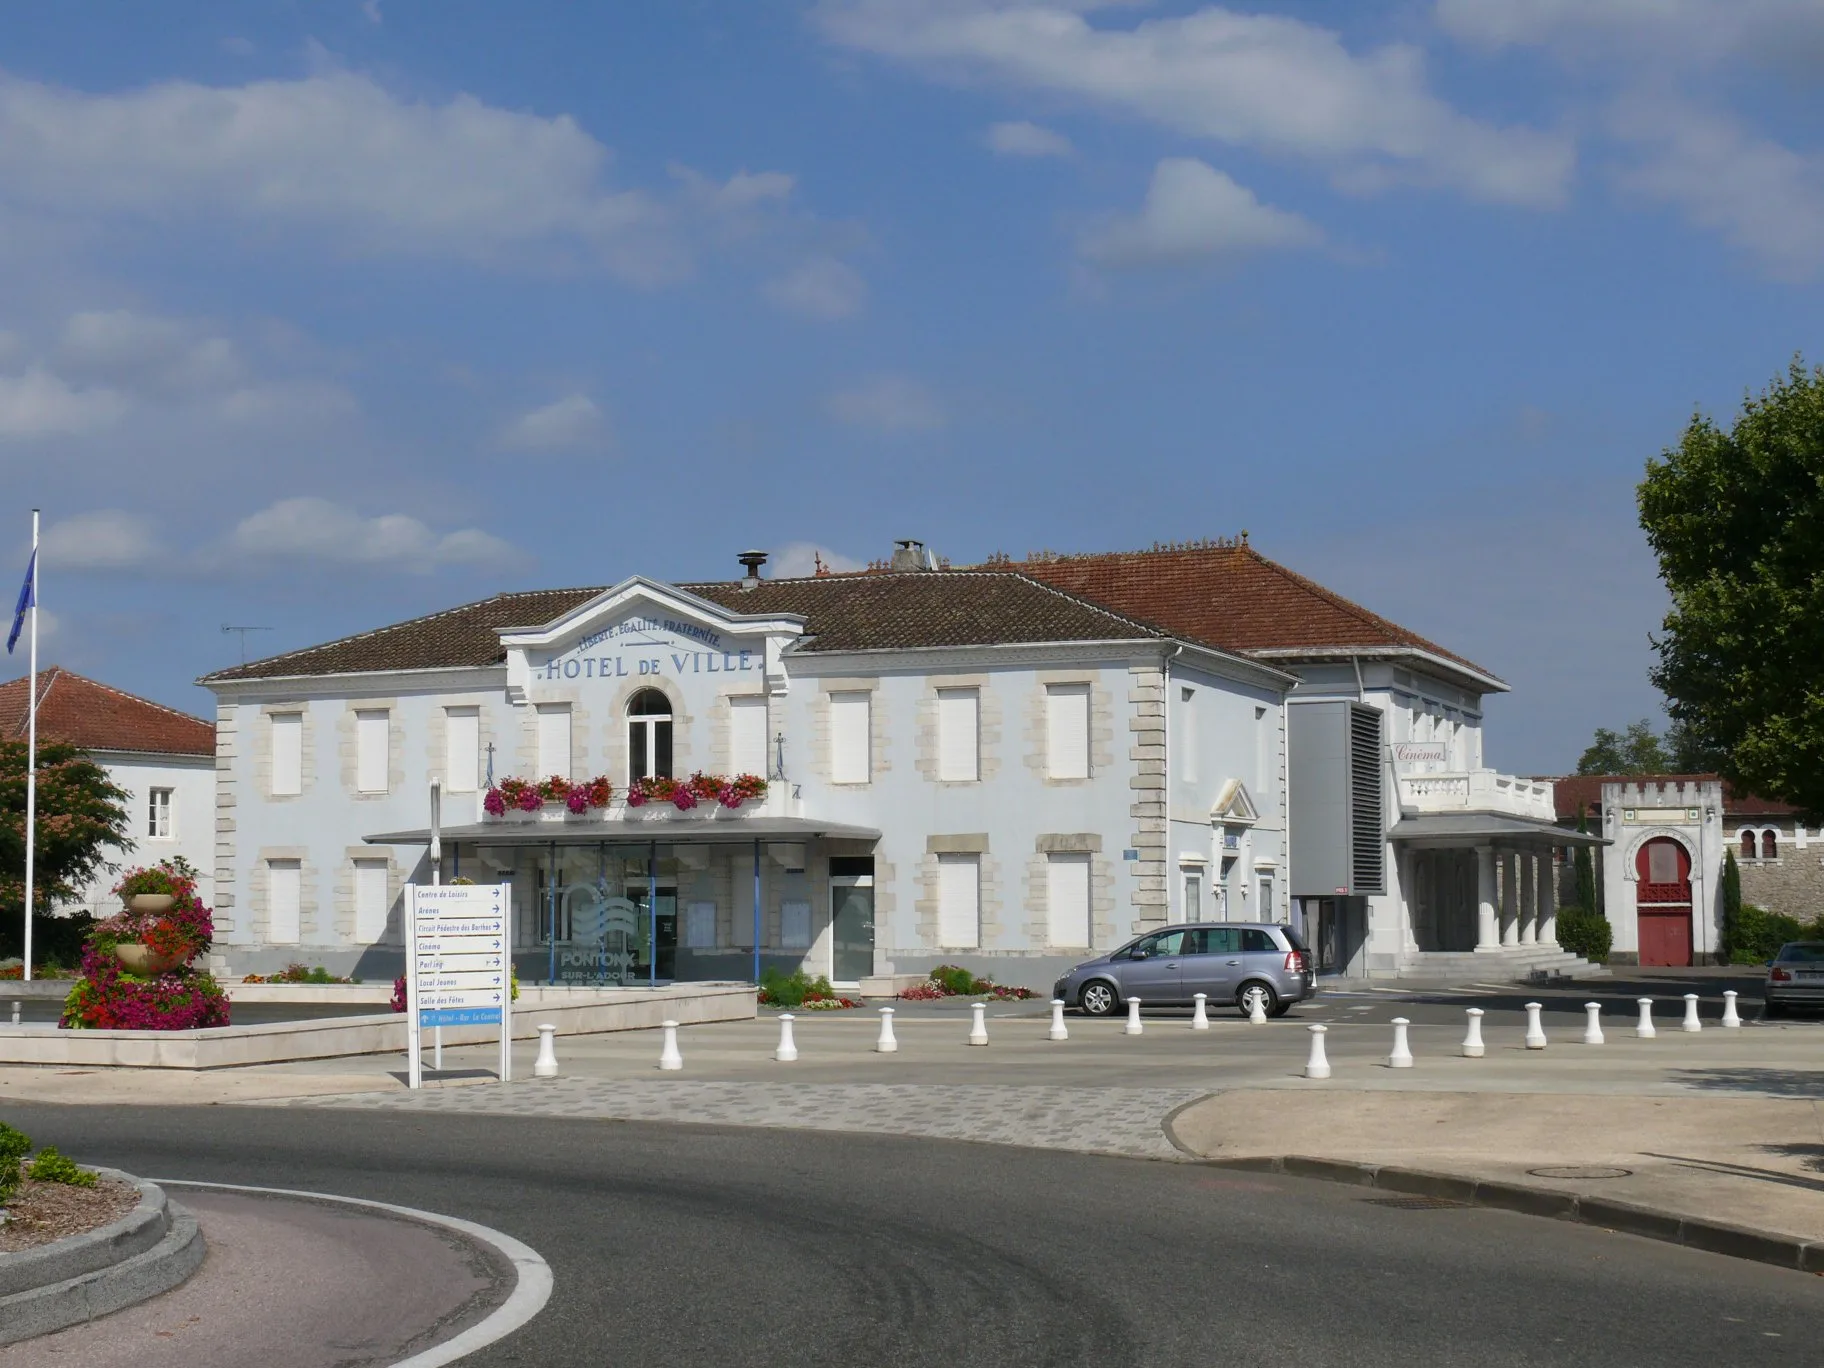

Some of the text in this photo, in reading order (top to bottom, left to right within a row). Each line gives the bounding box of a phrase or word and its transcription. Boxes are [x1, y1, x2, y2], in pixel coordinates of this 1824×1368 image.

[638, 659, 661, 676] DE
[670, 649, 753, 675] VILLE
[448, 890, 468, 898] Loisirs
[460, 923, 470, 931] des
[436, 978, 457, 986] Jeunes
[420, 997, 435, 1005] Salle
